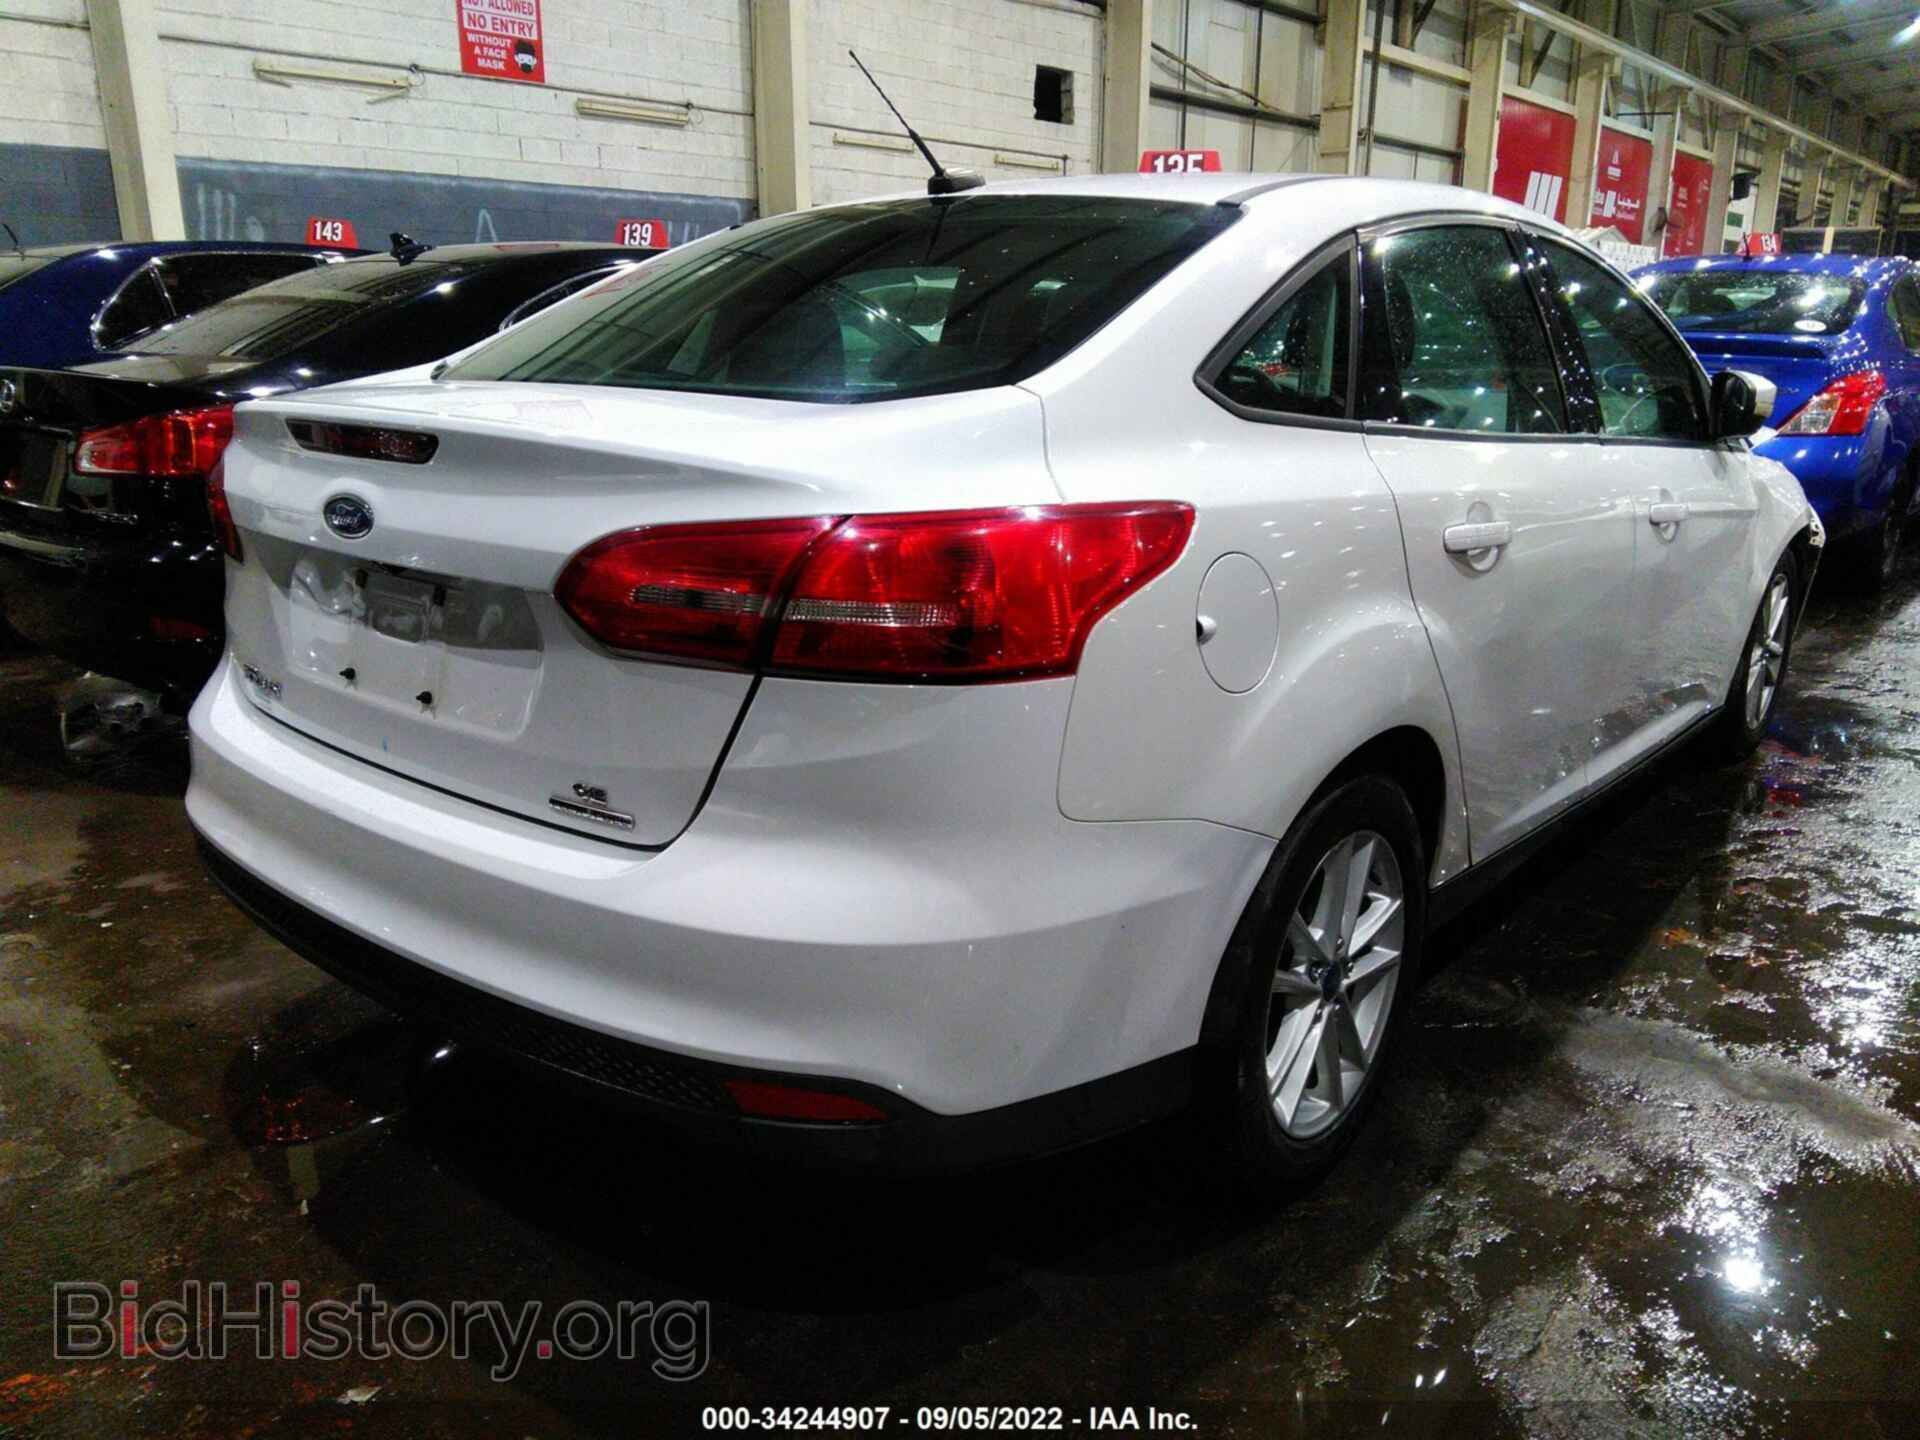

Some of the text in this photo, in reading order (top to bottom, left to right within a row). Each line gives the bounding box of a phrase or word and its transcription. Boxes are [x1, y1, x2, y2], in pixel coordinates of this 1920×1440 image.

[489, 0, 534, 15] ALLOWED
[467, 12, 534, 37] NO ENTRY
[466, 31, 512, 48] WITHOUT
[474, 45, 507, 60] A FACE
[477, 58, 505, 70] MASK
[315, 220, 342, 241] 143
[623, 223, 652, 245] 139
